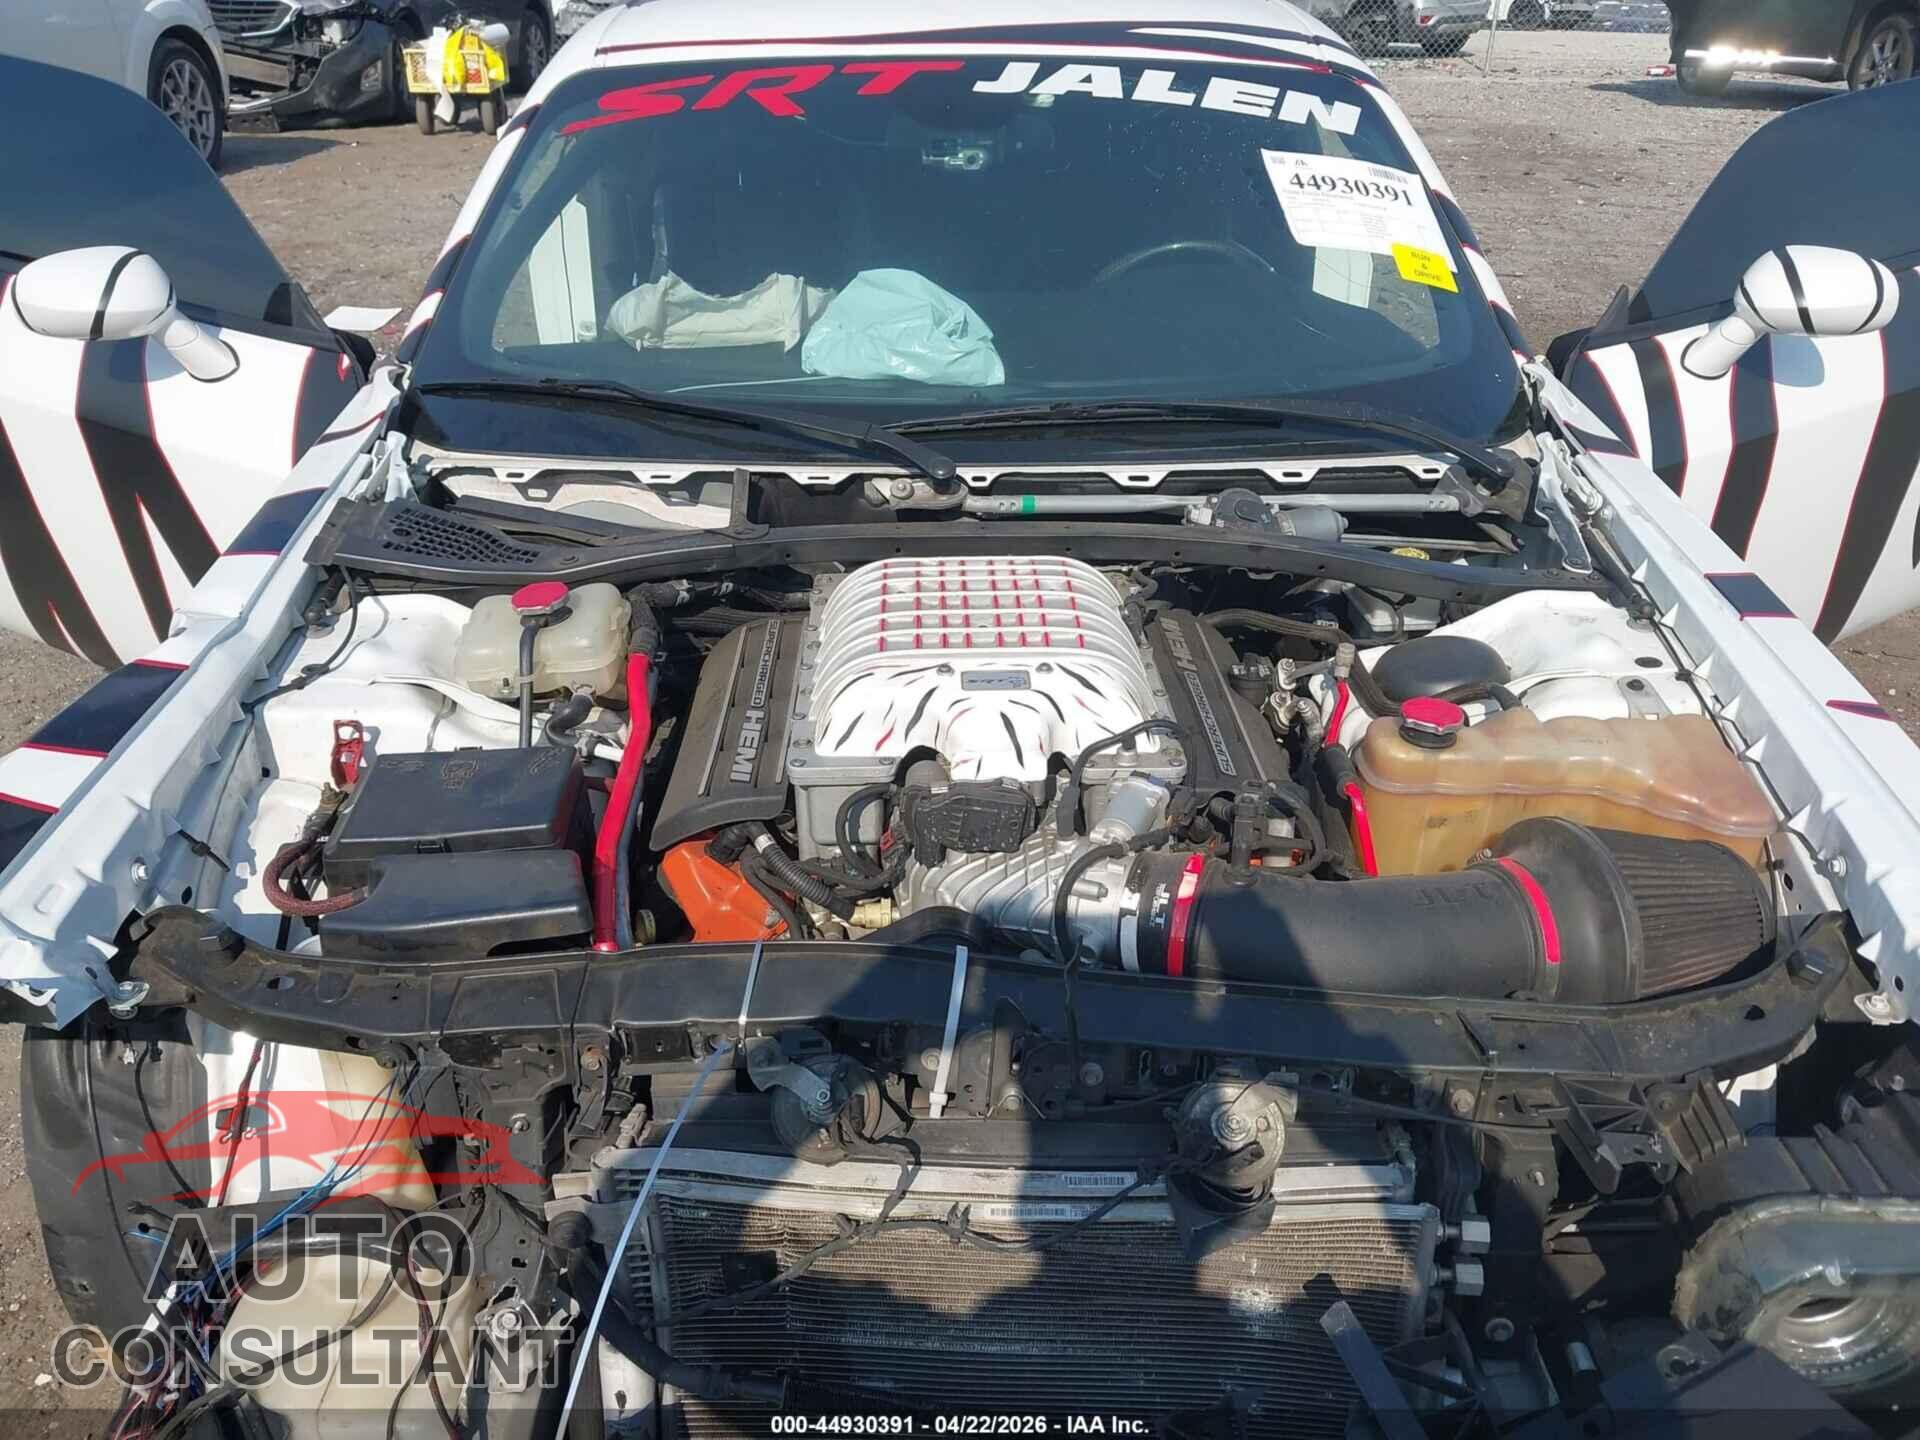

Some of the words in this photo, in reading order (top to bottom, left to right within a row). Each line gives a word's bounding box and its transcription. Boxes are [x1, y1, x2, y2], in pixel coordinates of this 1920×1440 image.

[559, 61, 966, 136] SRT
[972, 61, 1362, 136] JALEN
[1289, 172, 1413, 207] 44930391
[752, 618, 780, 706] SUPERCHARGED
[1160, 617, 1198, 672] HEMI
[730, 709, 765, 783] HEMI
